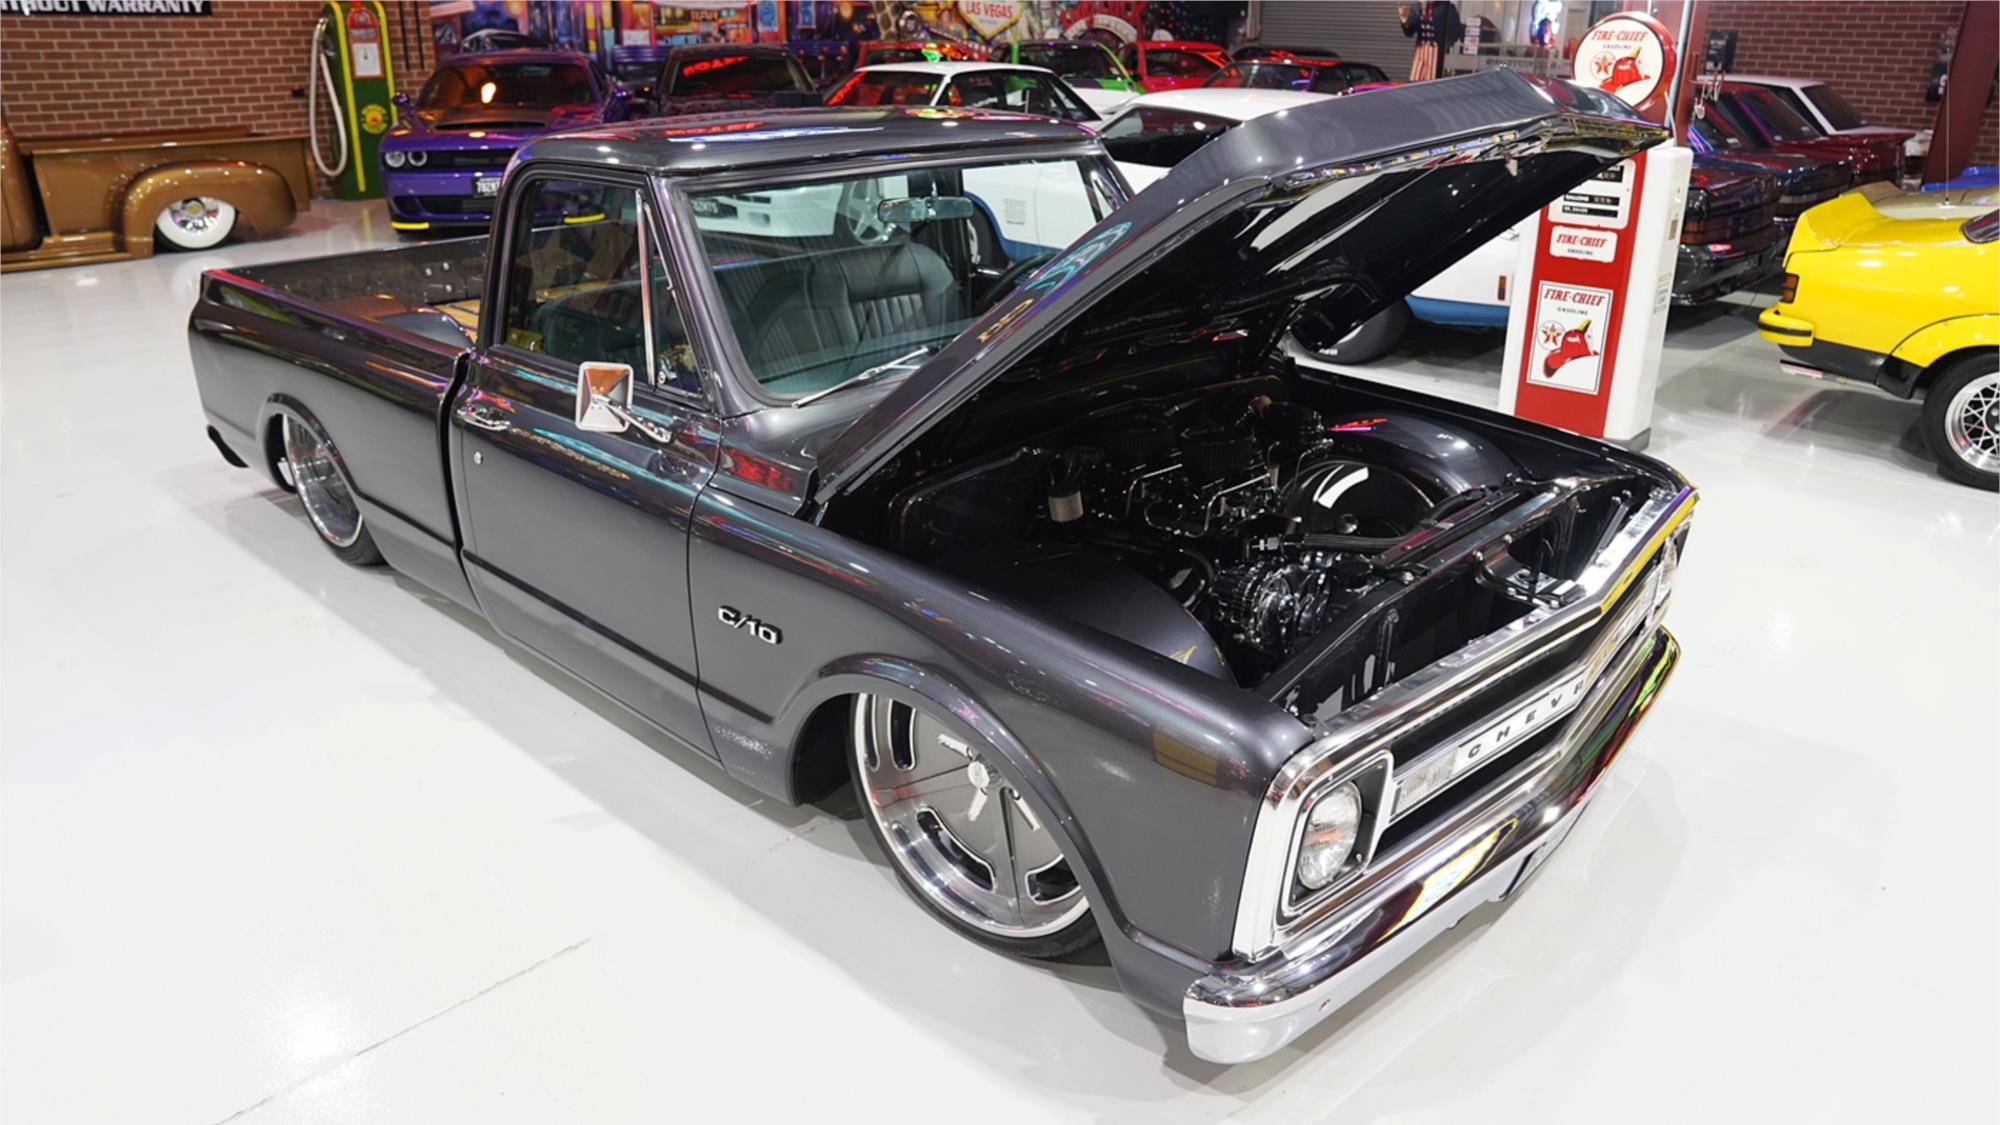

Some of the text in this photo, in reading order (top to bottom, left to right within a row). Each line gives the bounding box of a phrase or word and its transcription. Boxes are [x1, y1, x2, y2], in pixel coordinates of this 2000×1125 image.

[87, 0, 203, 14] WARRANTY
[984, 2, 1013, 19] VEGAS
[1591, 29, 1649, 42] FIRE-CHIEF
[1556, 233, 1608, 248] FIRE-CHIEF
[1543, 287, 1606, 307] FIRE-CHIEF
[1556, 306, 1589, 316] GASOLINE
[718, 606, 780, 645] C/10
